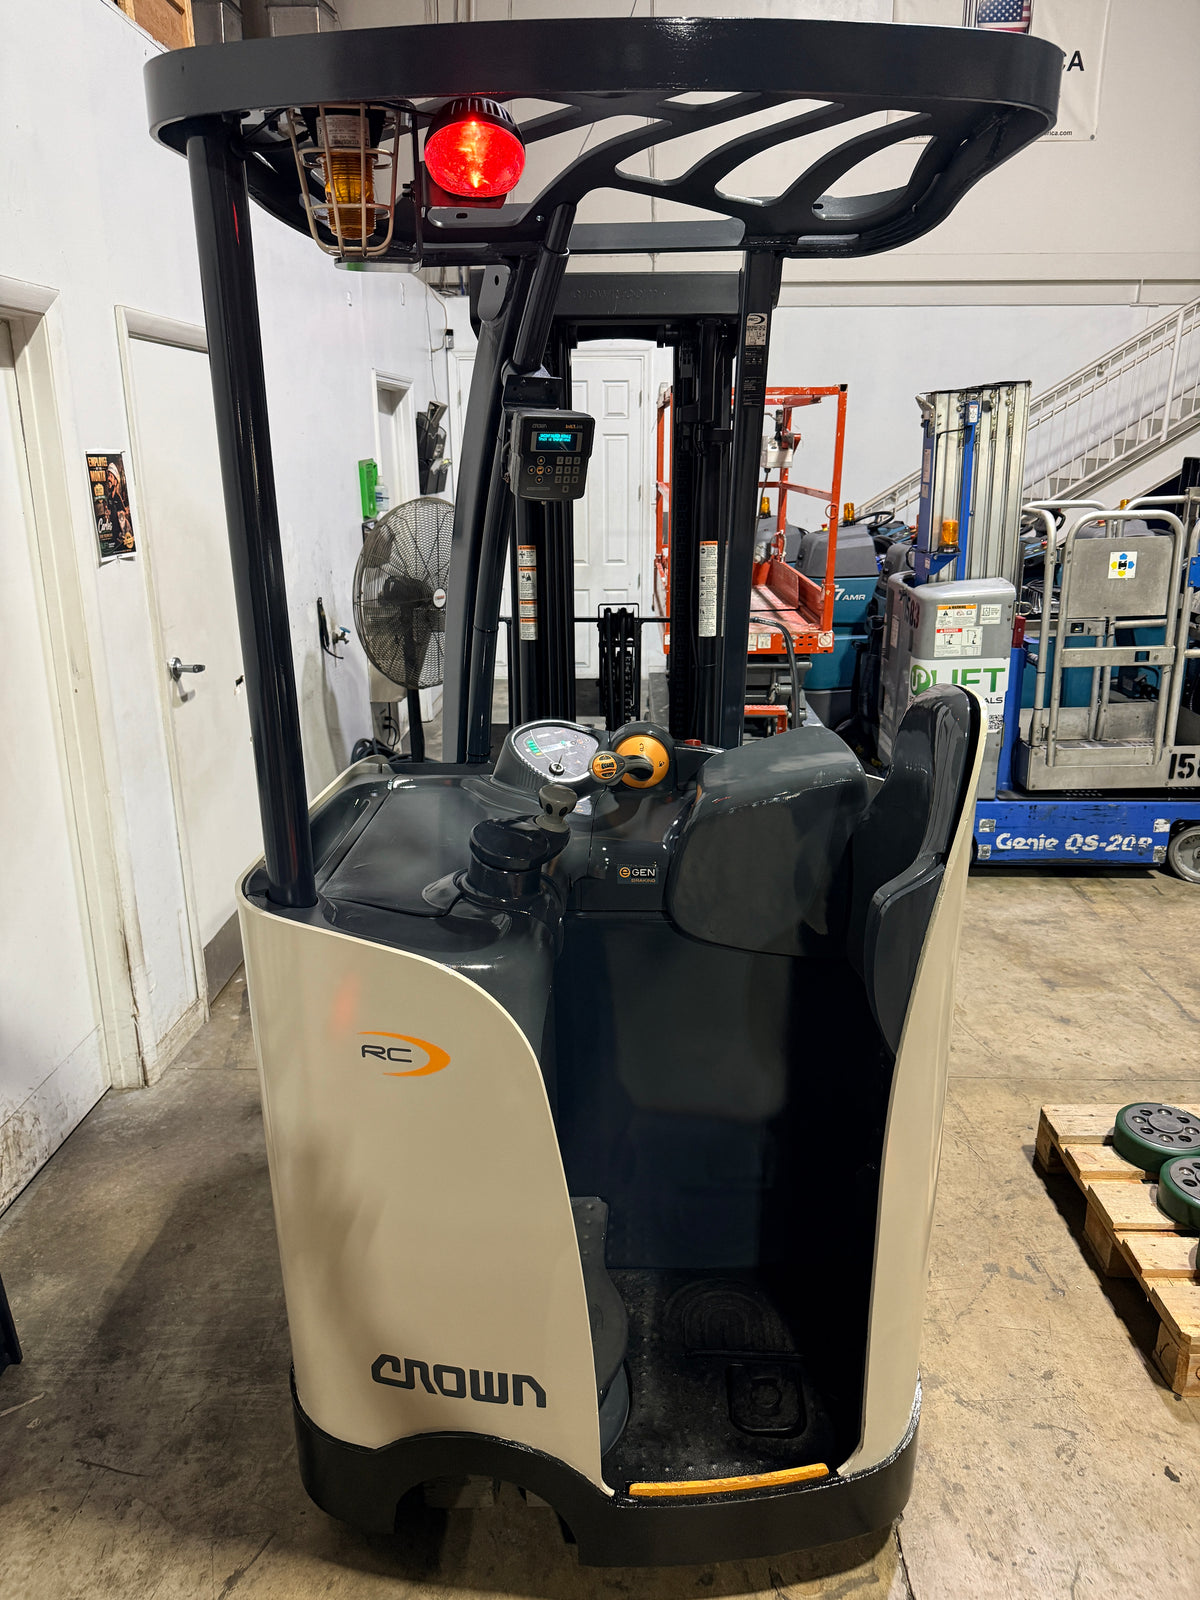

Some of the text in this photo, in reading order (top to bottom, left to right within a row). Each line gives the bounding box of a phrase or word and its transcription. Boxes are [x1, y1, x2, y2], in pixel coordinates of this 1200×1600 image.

[1062, 50, 1085, 71] A
[1168, 753, 1200, 780] 15
[996, 832, 1059, 852] Genie
[361, 1044, 413, 1063] RC
[371, 1353, 547, 1408] CROWN
